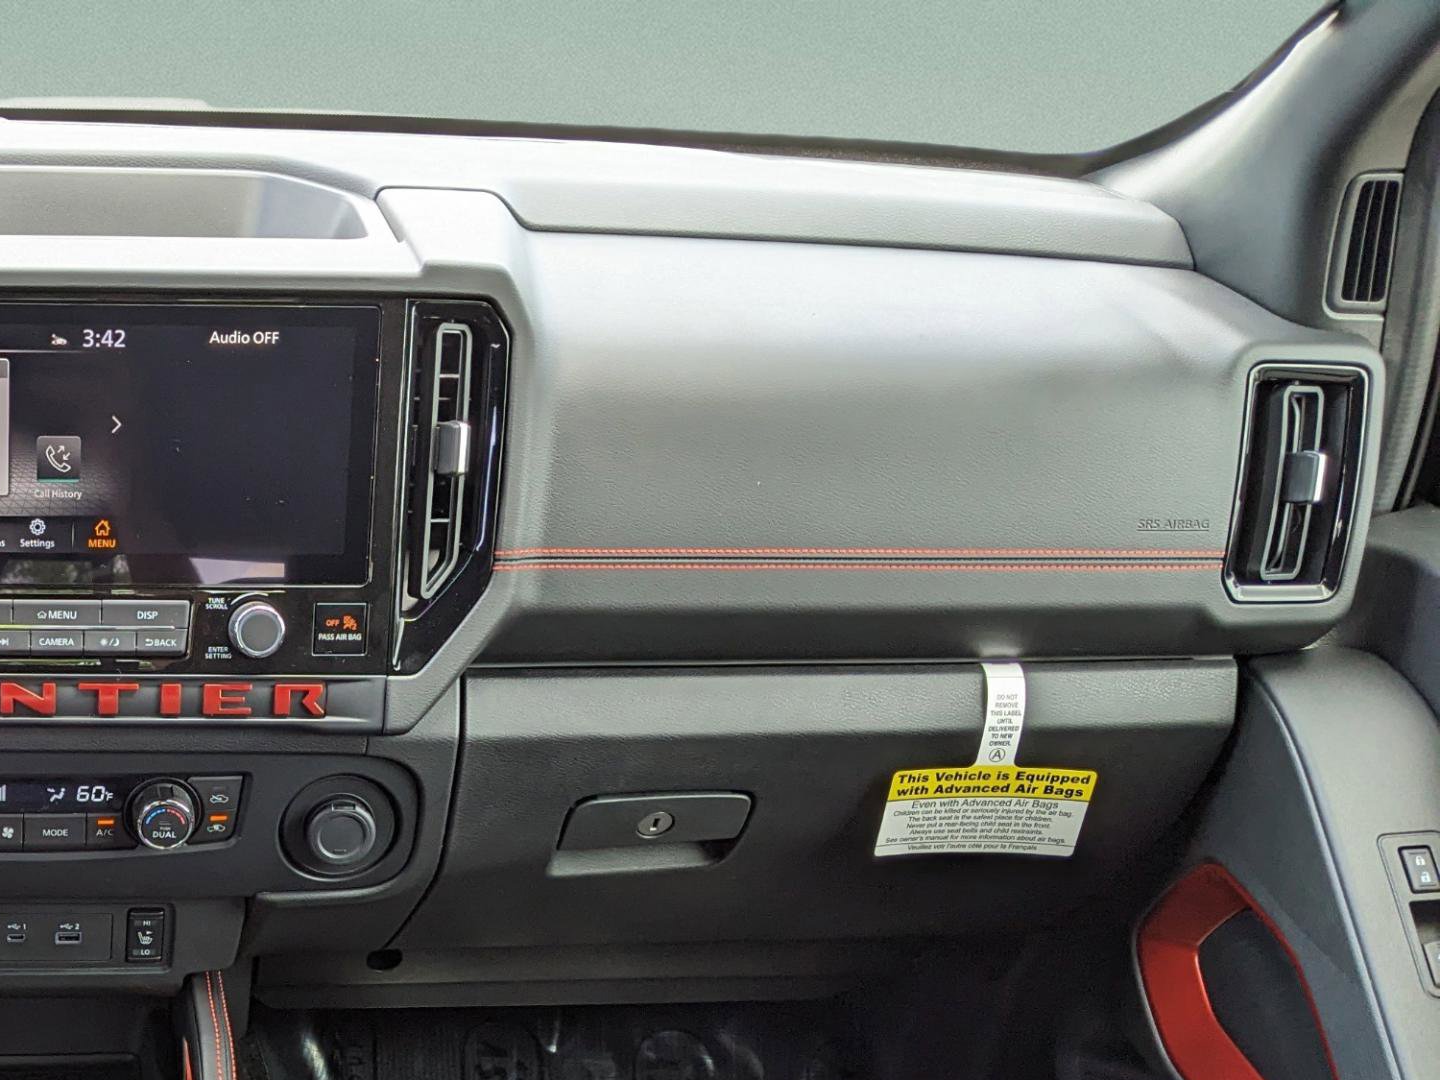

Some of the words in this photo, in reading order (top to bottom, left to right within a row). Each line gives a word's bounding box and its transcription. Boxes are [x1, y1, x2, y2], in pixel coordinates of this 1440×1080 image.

[82, 329, 126, 348] 3:42
[209, 331, 250, 345] Audio
[253, 331, 280, 344] OFF
[34, 489, 50, 499] Call
[51, 490, 82, 501] History
[1163, 519, 1210, 529] AIRBAG
[20, 538, 55, 549] Settings
[88, 539, 116, 548] MENU
[48, 610, 77, 620] MENU
[137, 610, 159, 620] DISP
[325, 619, 340, 627] OFF
[39, 637, 74, 647] CAMERA
[318, 633, 334, 641] PASS
[336, 633, 347, 641] AIR
[348, 633, 362, 641] BAG
[154, 638, 177, 647] BACK
[899, 774, 929, 784] This
[935, 771, 991, 781] Vehicle
[996, 771, 1010, 780] is
[1015, 771, 1091, 785] Equipped
[897, 785, 928, 796] with
[933, 783, 1010, 794] Advanced
[1015, 784, 1039, 794] Air
[1043, 785, 1084, 798] Bags
[912, 800, 937, 809] Even
[961, 799, 1013, 808] Advanced
[1014, 799, 1029, 807] Air
[1032, 800, 1059, 810] Bags
[43, 829, 68, 837] MODE
[96, 829, 113, 837] A/C
[152, 831, 177, 839] DUAL
